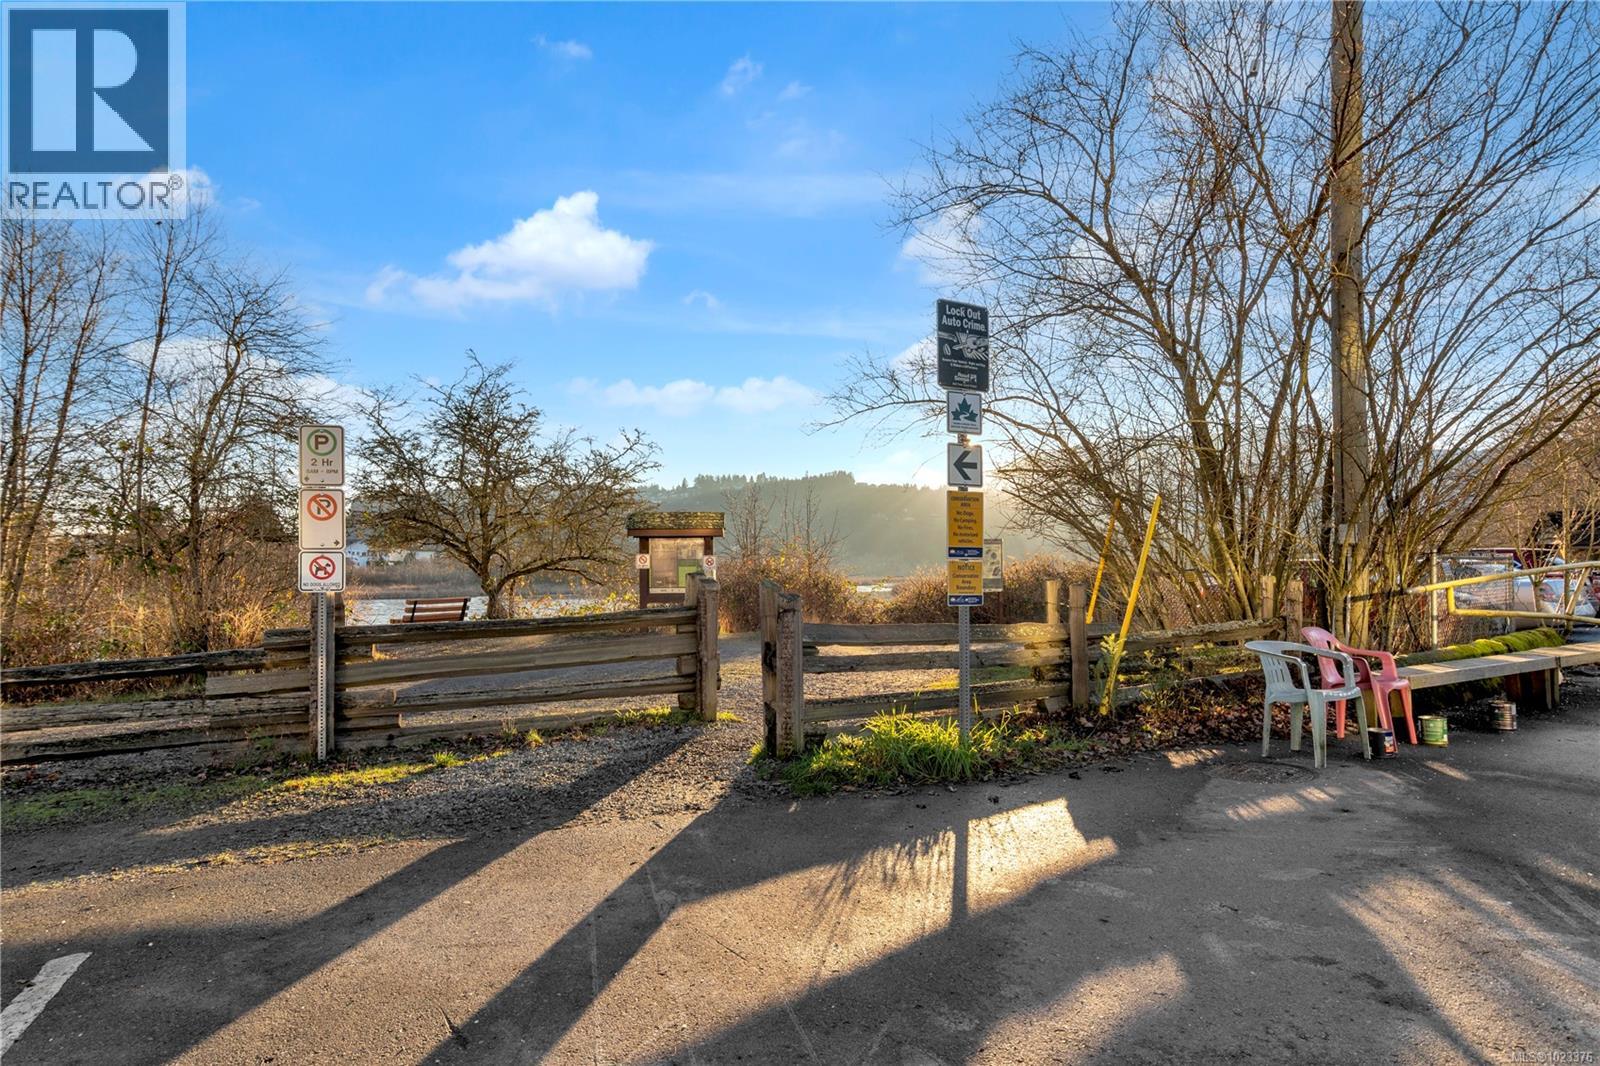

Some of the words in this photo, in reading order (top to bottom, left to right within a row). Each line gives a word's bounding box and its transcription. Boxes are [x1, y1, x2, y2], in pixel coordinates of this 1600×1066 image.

[945, 304, 966, 317] Lock
[966, 308, 982, 321] Out
[941, 315, 962, 327] Auto
[962, 319, 987, 332] Crime.
[314, 434, 329, 451] P
[310, 458, 318, 467] 2
[321, 458, 334, 467] Hr
